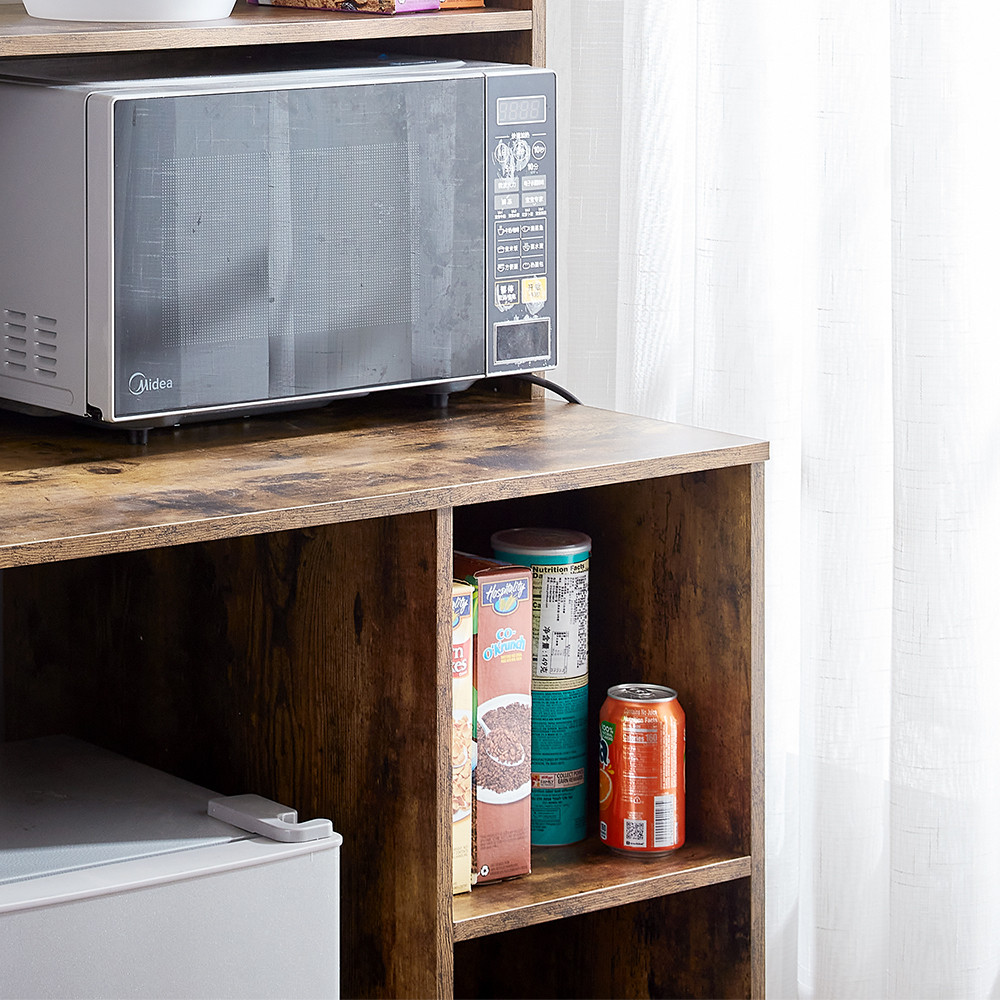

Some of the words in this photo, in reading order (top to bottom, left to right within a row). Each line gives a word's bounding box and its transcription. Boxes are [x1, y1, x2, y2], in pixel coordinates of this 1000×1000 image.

[128, 371, 173, 395] Midea
[485, 580, 526, 603] Hospitality
[482, 635, 526, 661] O'Krunch
